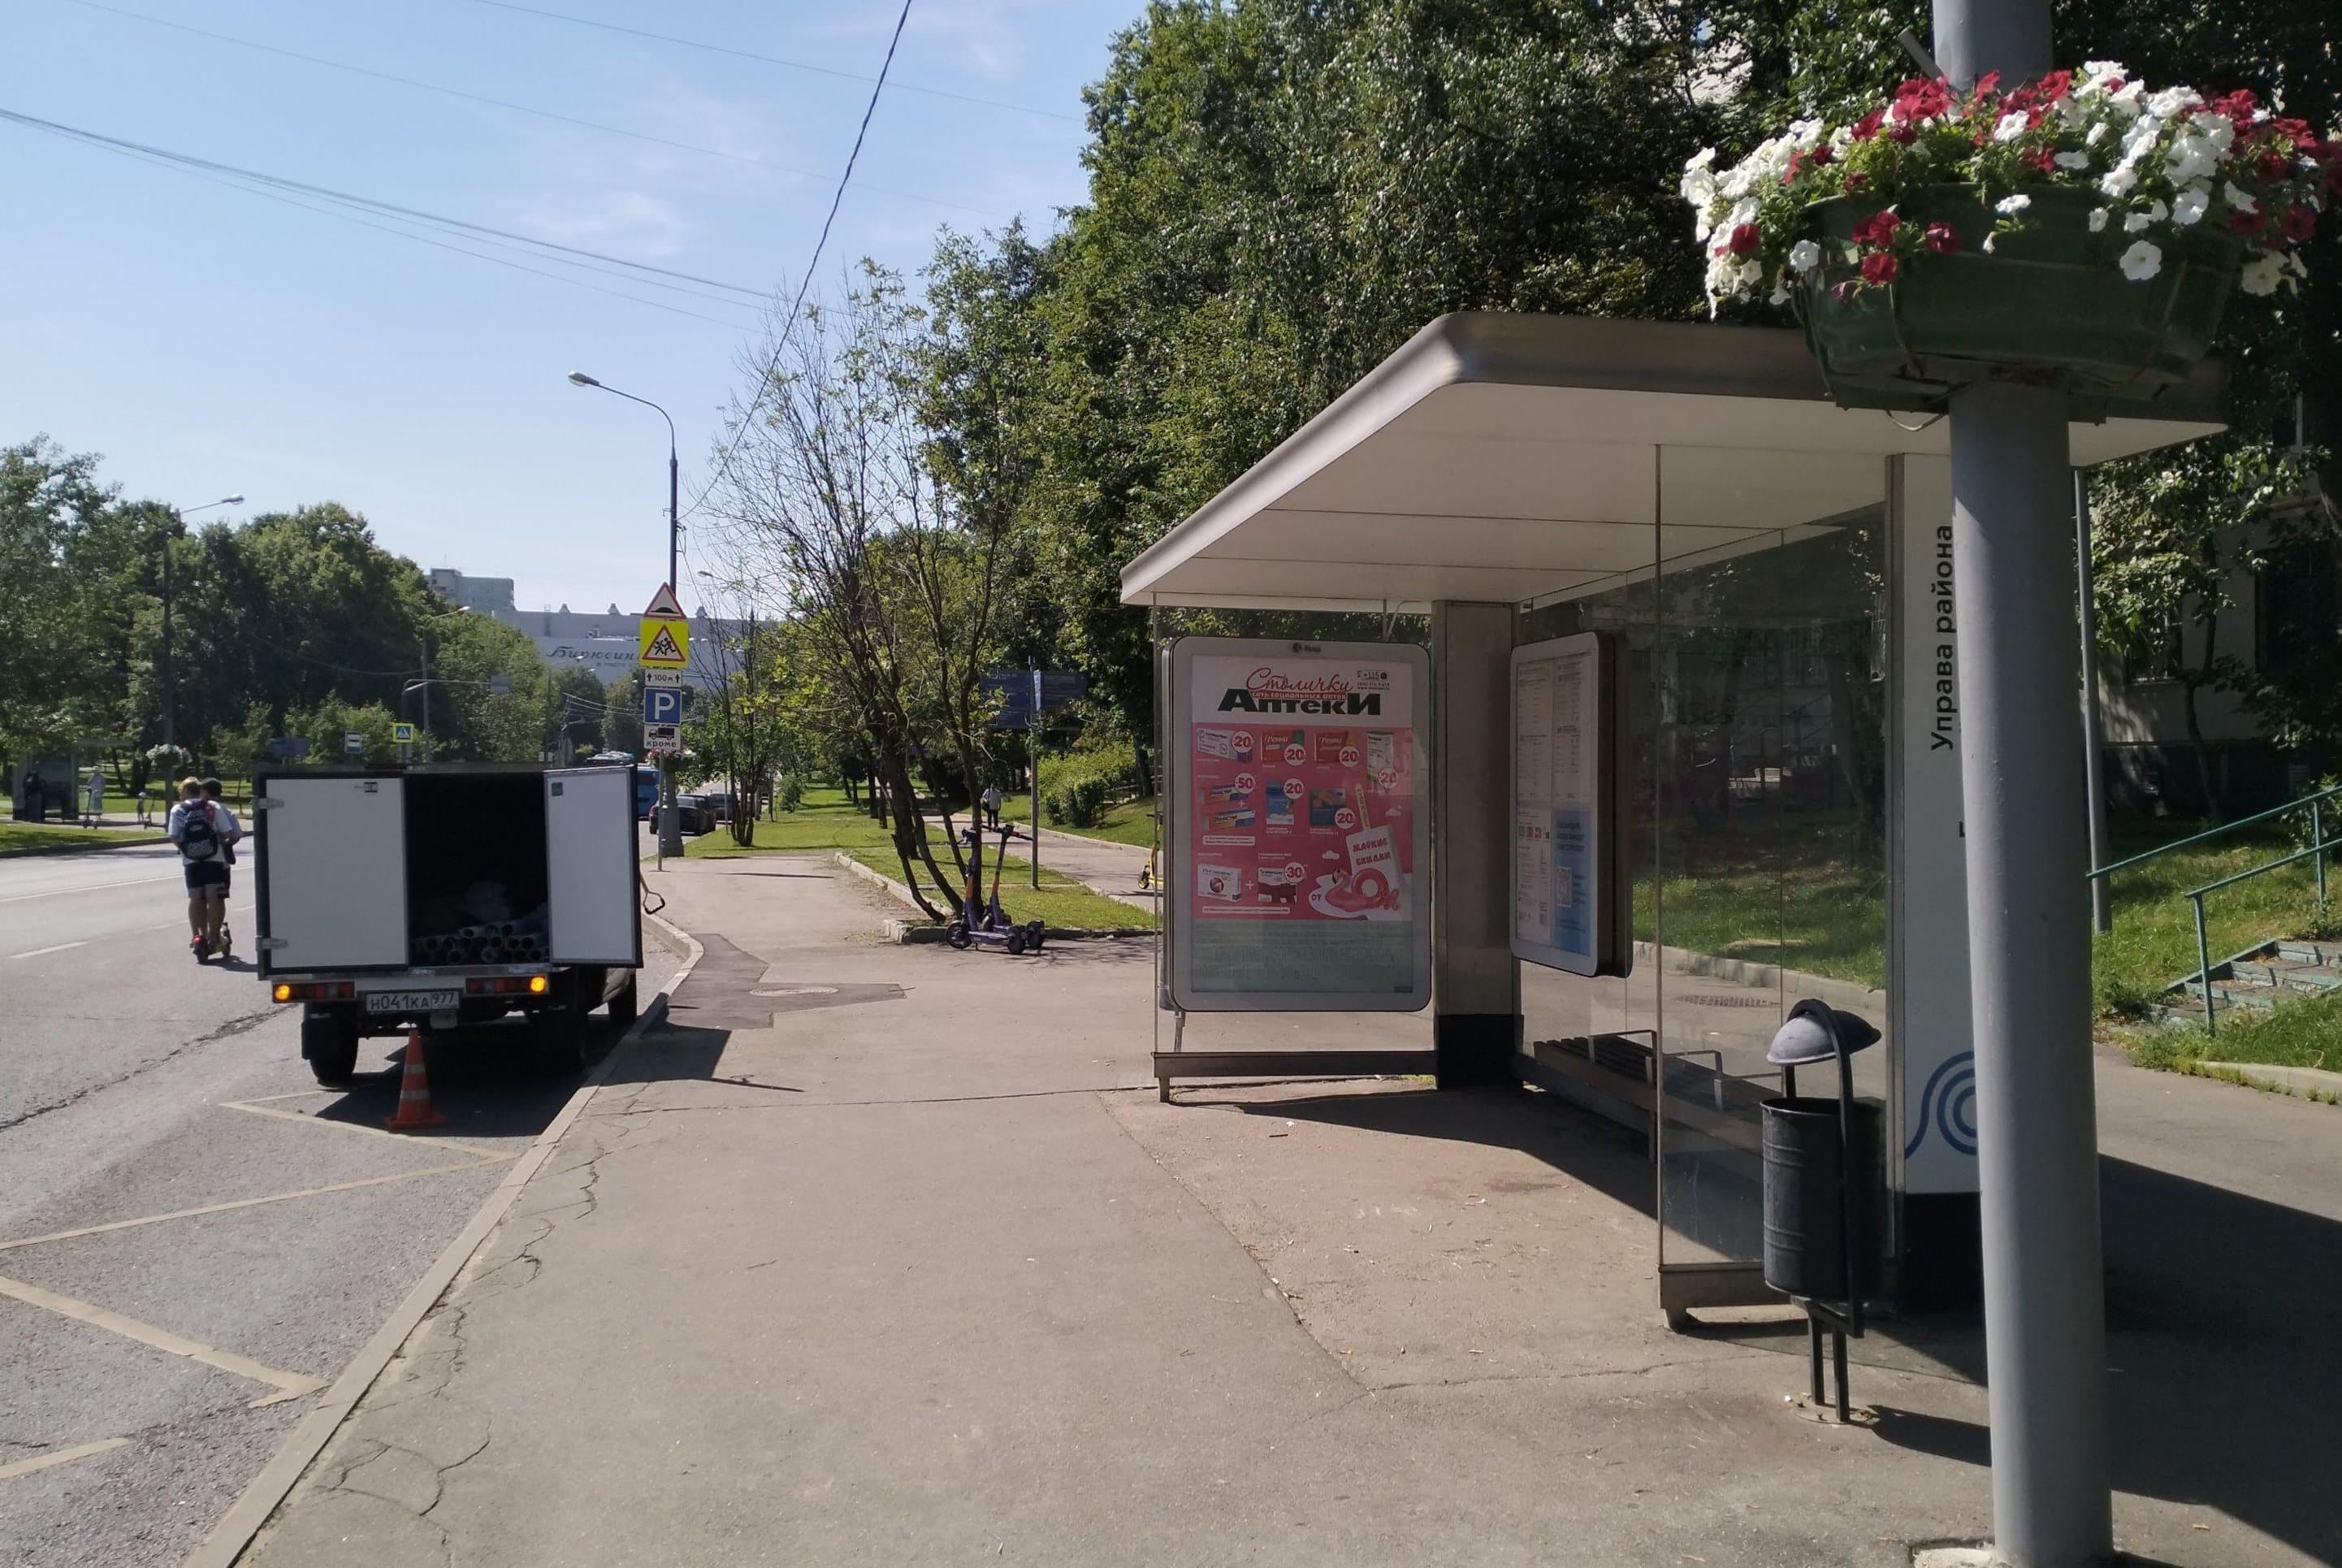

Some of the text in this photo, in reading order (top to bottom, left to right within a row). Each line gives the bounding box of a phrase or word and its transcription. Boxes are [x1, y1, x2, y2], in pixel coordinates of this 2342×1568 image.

[1931, 525, 1959, 751] Управа района
[546, 646, 640, 662] Бирюсин
[1246, 667, 1353, 692] Столички
[654, 692, 675, 720] P
[647, 740, 677, 749] кроме
